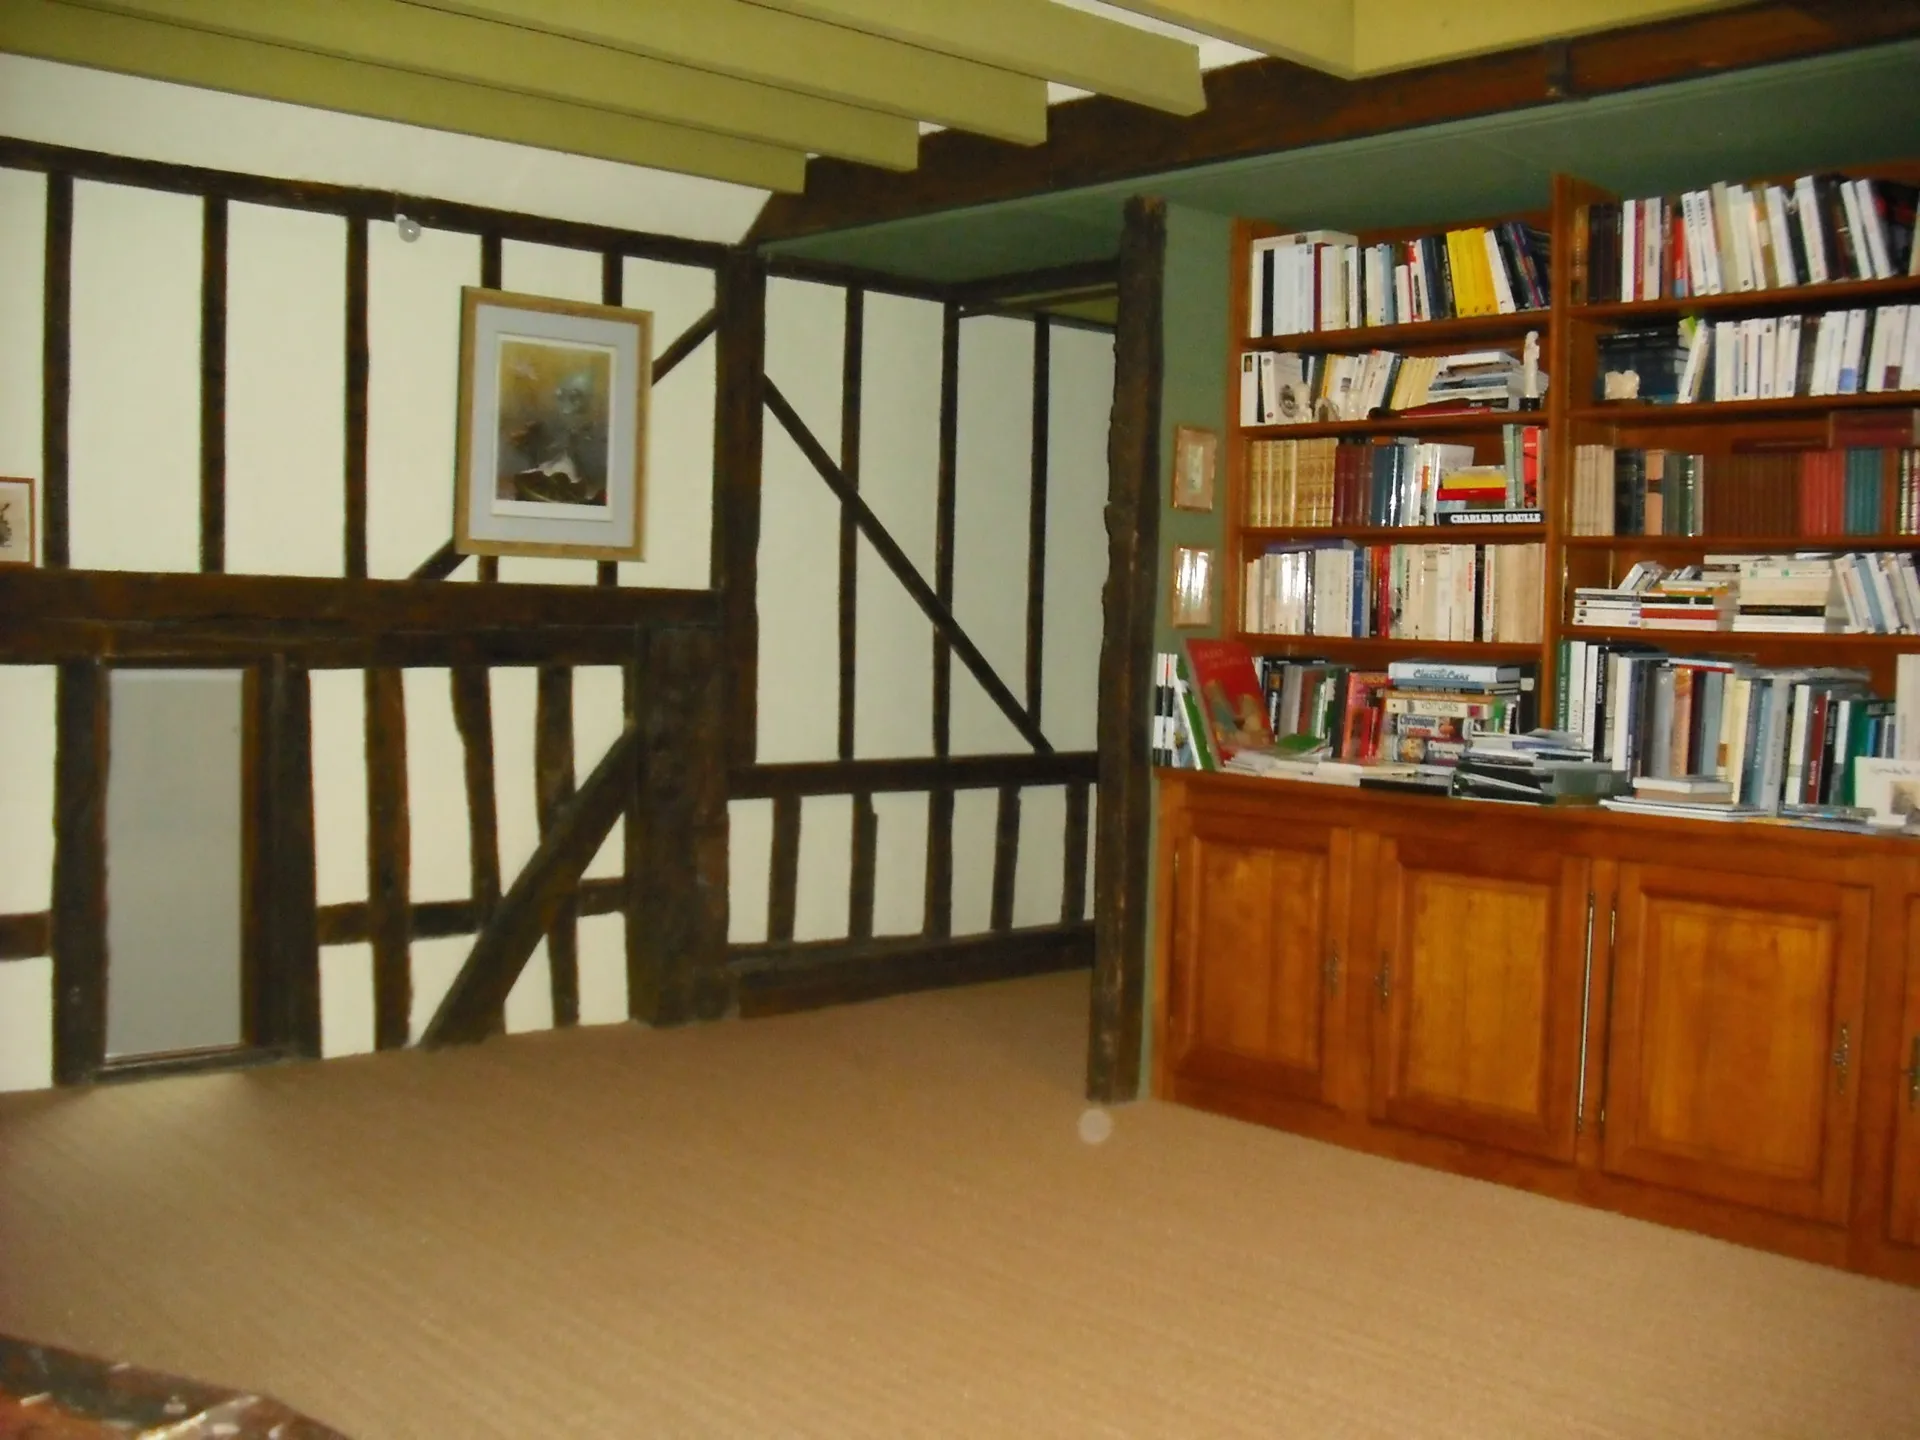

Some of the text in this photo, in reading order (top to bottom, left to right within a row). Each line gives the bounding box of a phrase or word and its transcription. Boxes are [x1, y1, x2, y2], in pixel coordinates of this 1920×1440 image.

[1450, 513, 1541, 524] CHARLES DE GAULLE
